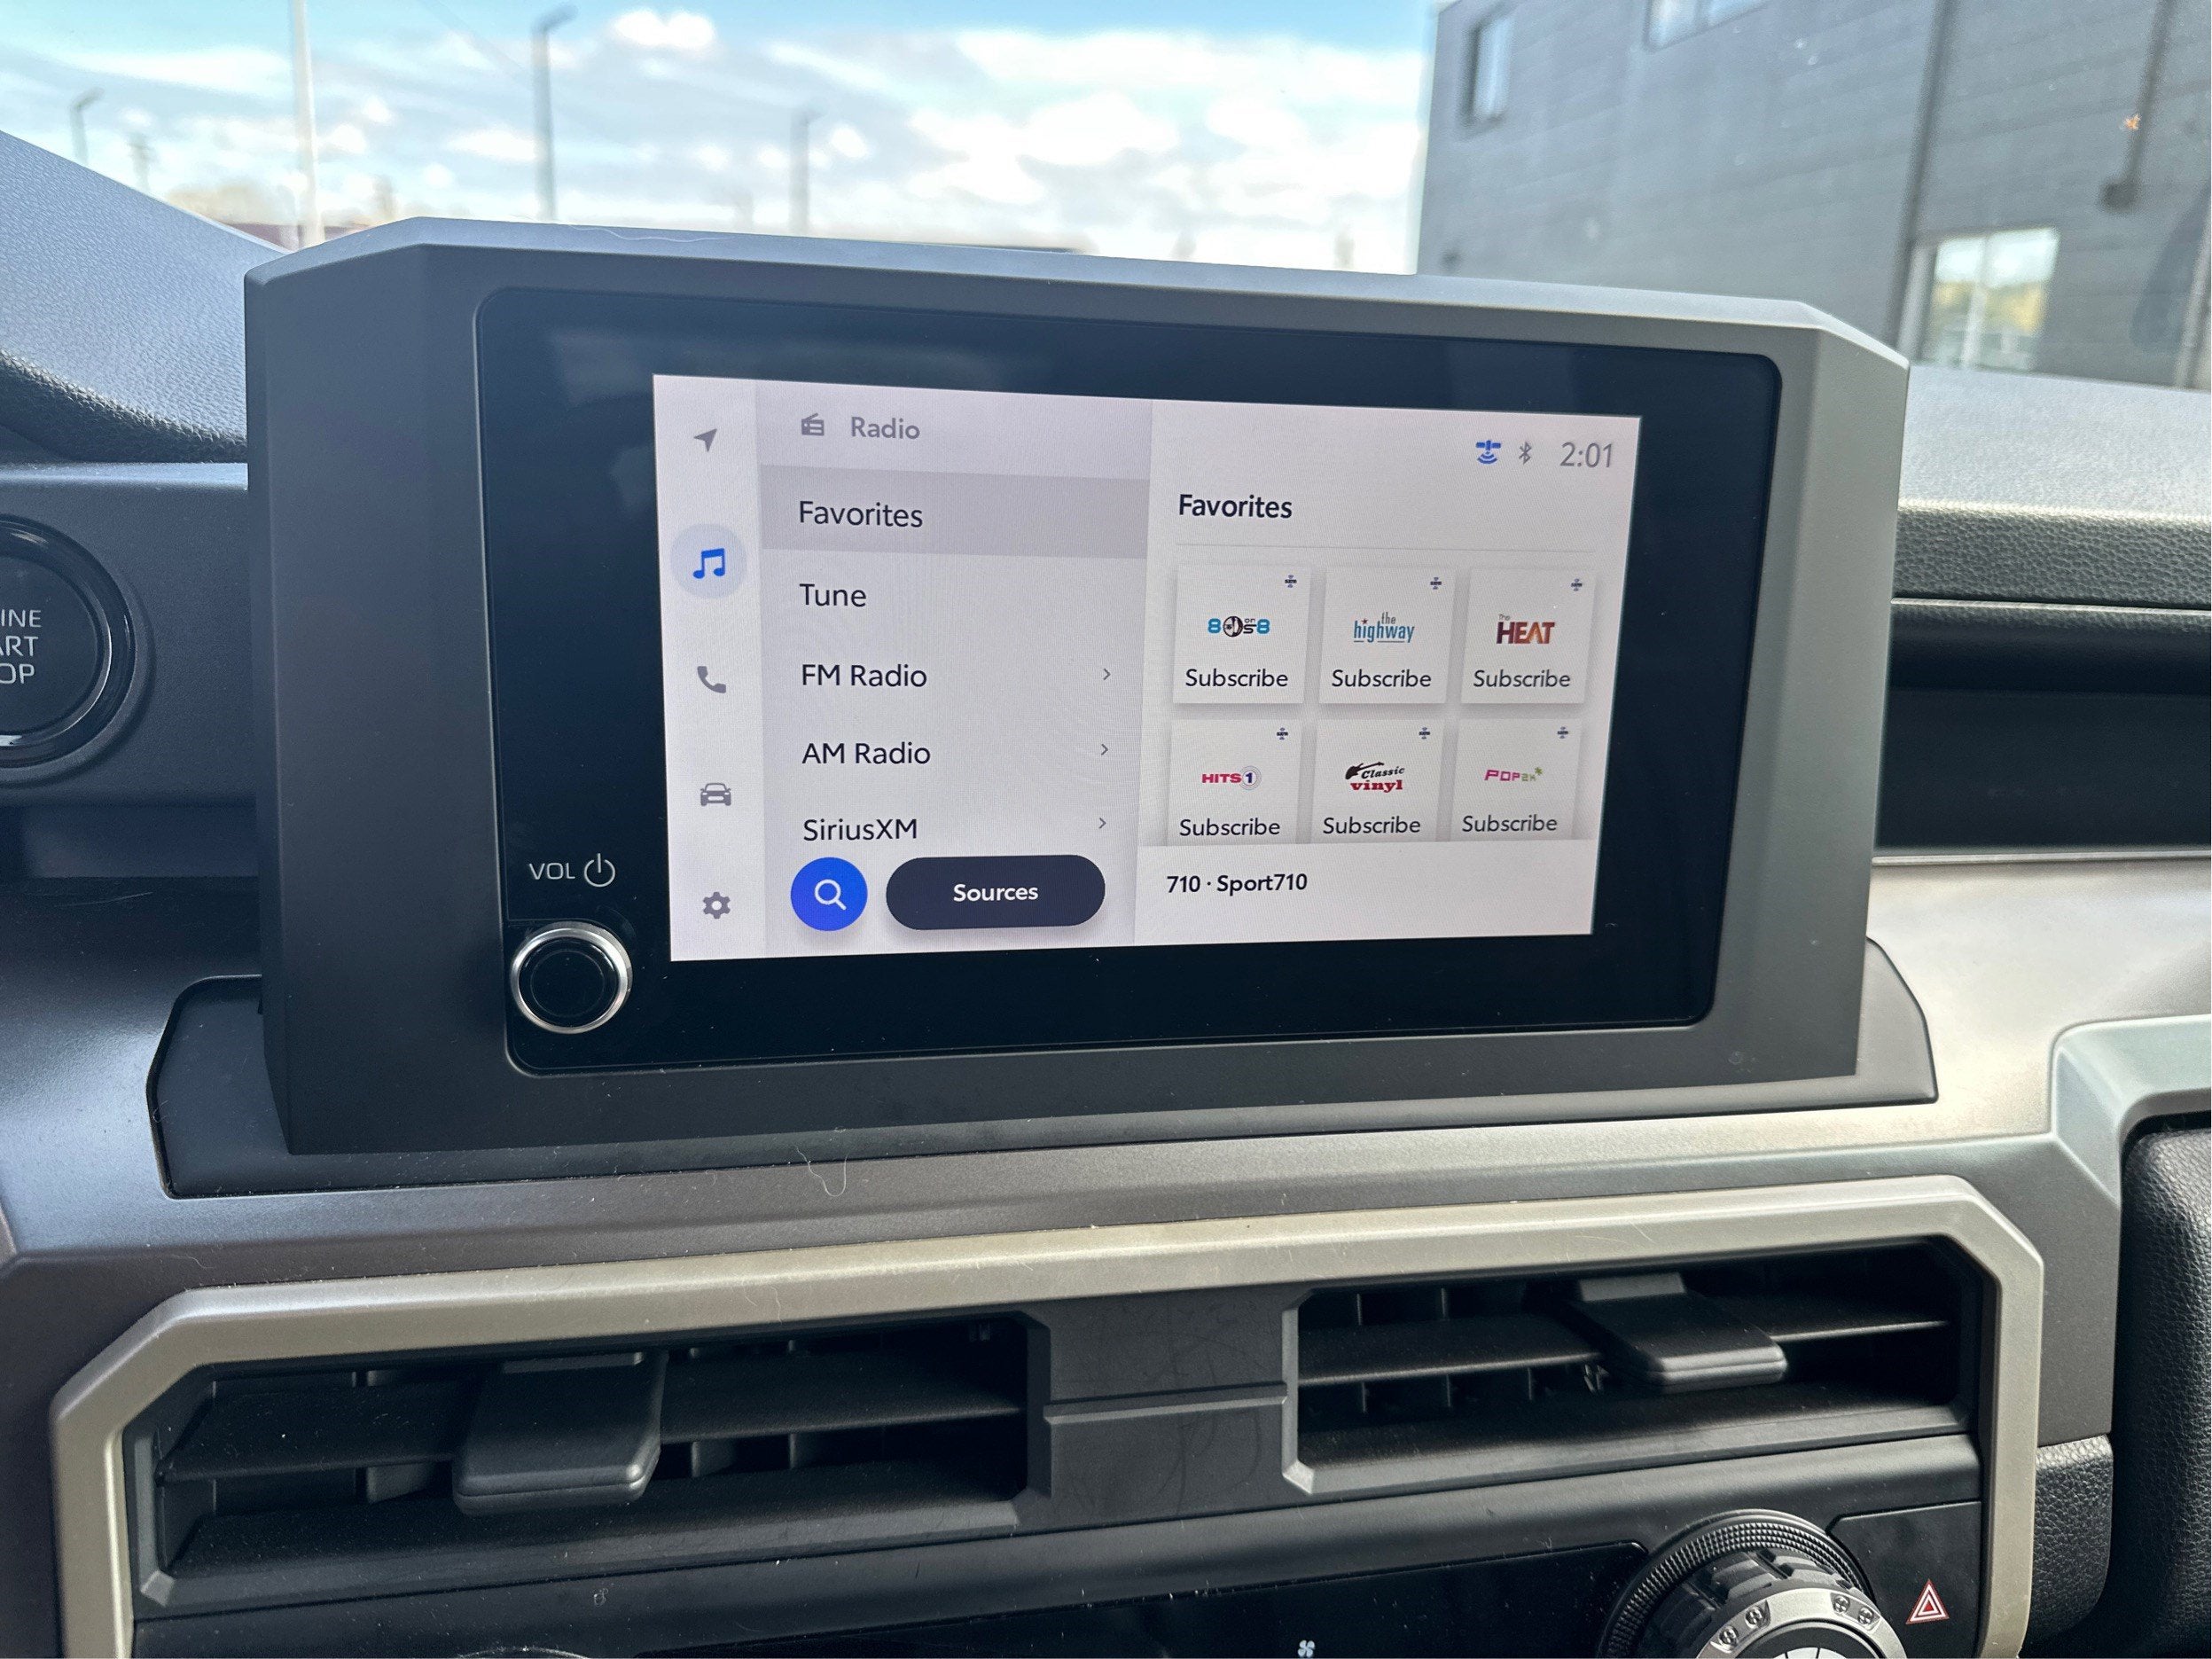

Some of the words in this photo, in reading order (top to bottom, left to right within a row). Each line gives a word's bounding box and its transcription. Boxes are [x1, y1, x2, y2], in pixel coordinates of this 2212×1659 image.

[851, 416, 920, 440] Radio
[1559, 442, 1614, 468] 2:01
[799, 500, 923, 528] Favorites
[1179, 494, 1293, 519] Favorites
[799, 583, 867, 607] Tune
[1381, 611, 1396, 624] the
[1353, 620, 1415, 643] highway
[1496, 622, 1556, 645] HEAT
[801, 664, 840, 686] FM
[850, 663, 927, 688] Radio
[1185, 668, 1289, 688] Subscribe
[1332, 669, 1432, 688] Subscribe
[1473, 669, 1571, 688] Subscribe
[801, 742, 845, 764] AM
[855, 741, 931, 764] Radio
[1201, 773, 1242, 784] HITS
[1245, 772, 1253, 784] 1
[1361, 765, 1405, 779] Classic
[1349, 779, 1403, 794] vinyl
[802, 818, 918, 842] SiriusXM
[1179, 817, 1281, 836] Subscribe
[1322, 815, 1421, 834] Subscribe
[1462, 813, 1558, 833] Subscribe
[528, 862, 576, 880] VOL
[953, 883, 1039, 903] Sources
[1167, 875, 1201, 893] 710
[1216, 873, 1308, 896] Sport710
